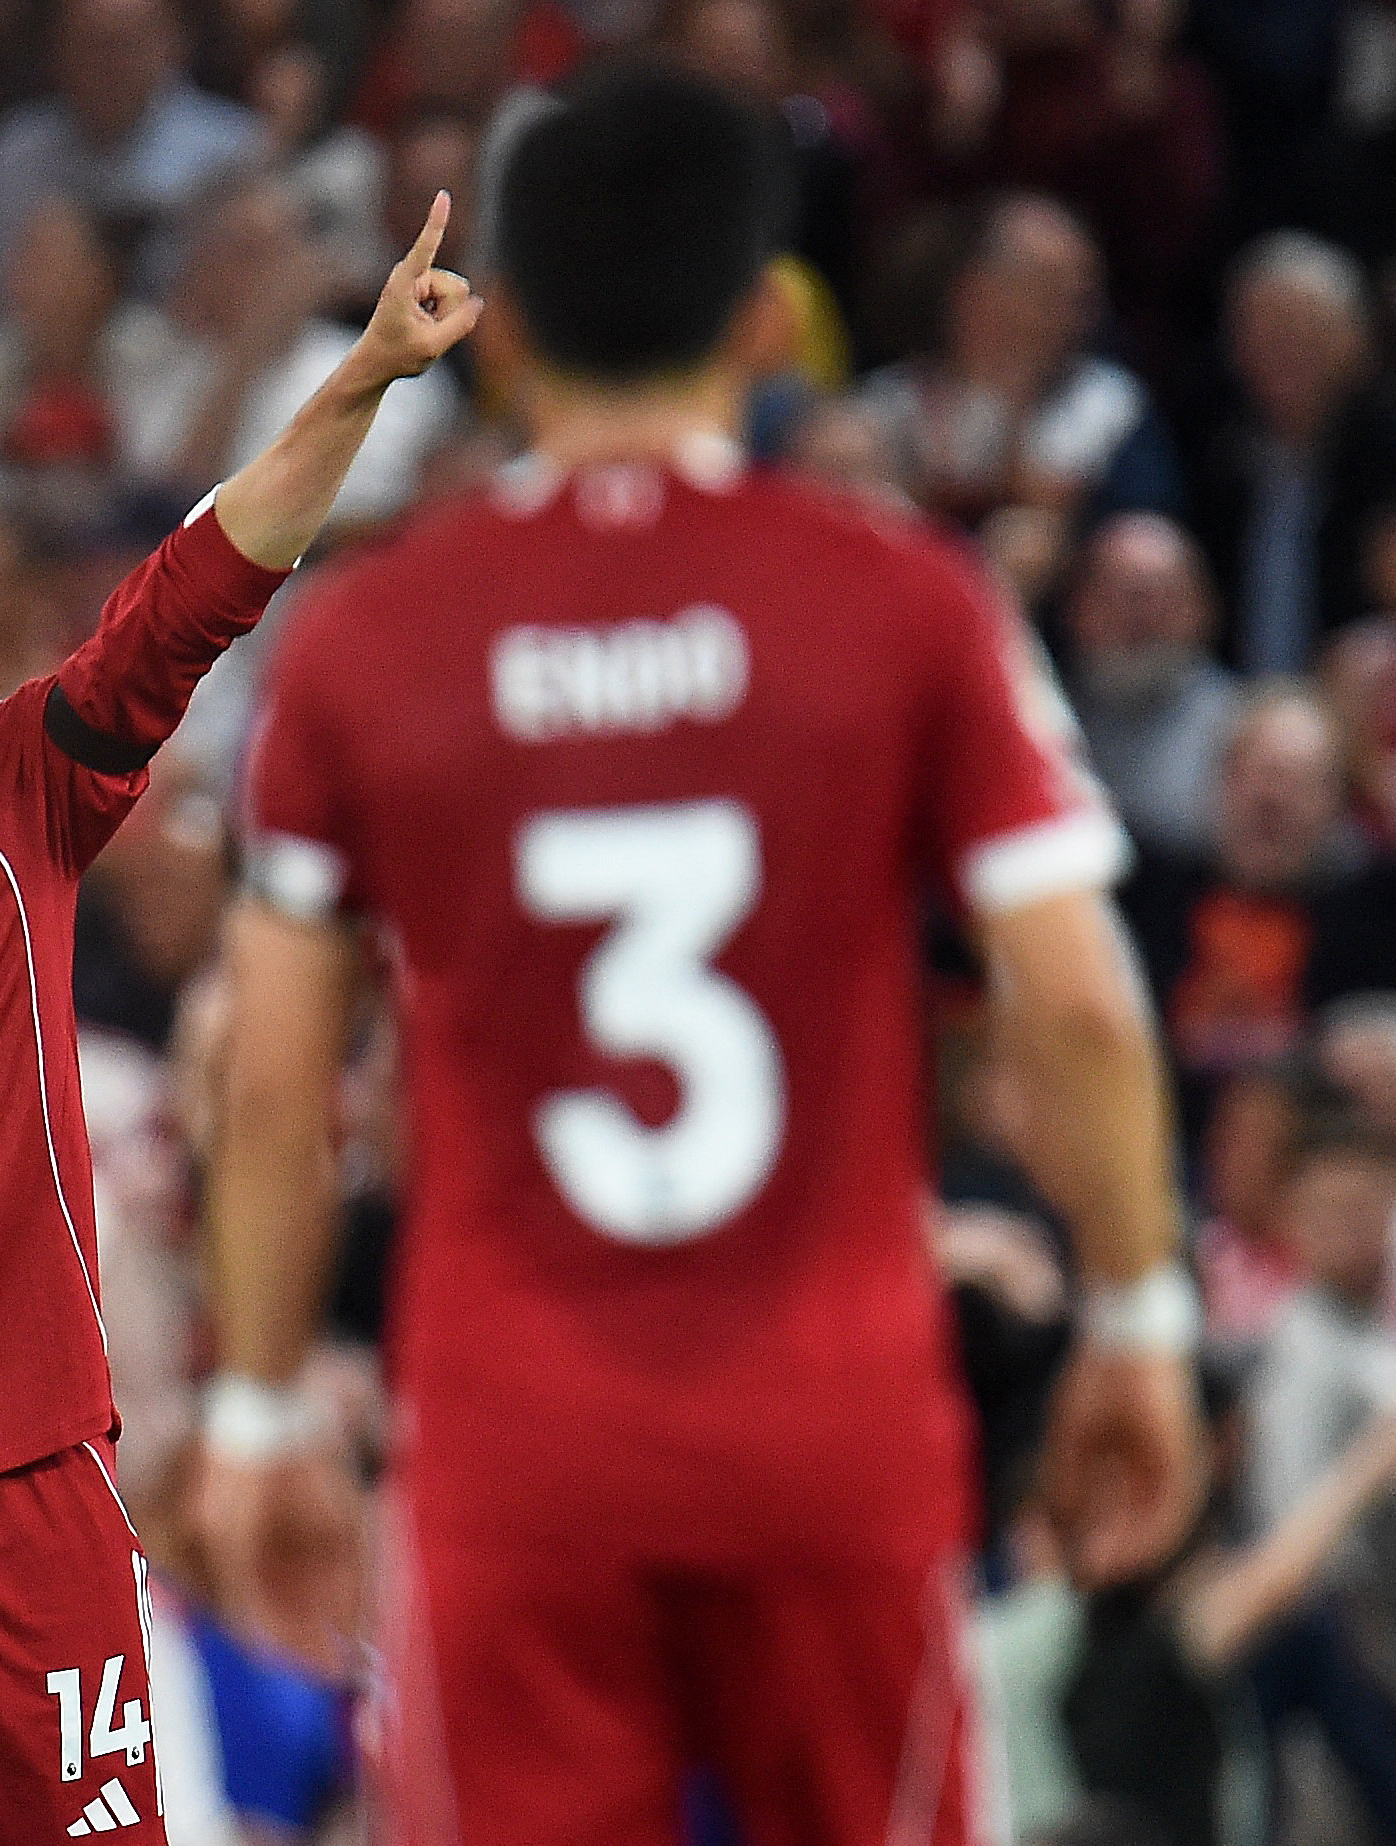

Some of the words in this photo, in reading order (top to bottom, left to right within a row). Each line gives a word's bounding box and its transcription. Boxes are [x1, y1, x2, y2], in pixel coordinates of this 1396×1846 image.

[491, 606, 750, 741] ENDO
[516, 800, 784, 1242] 3
[46, 1654, 152, 1783] 14
